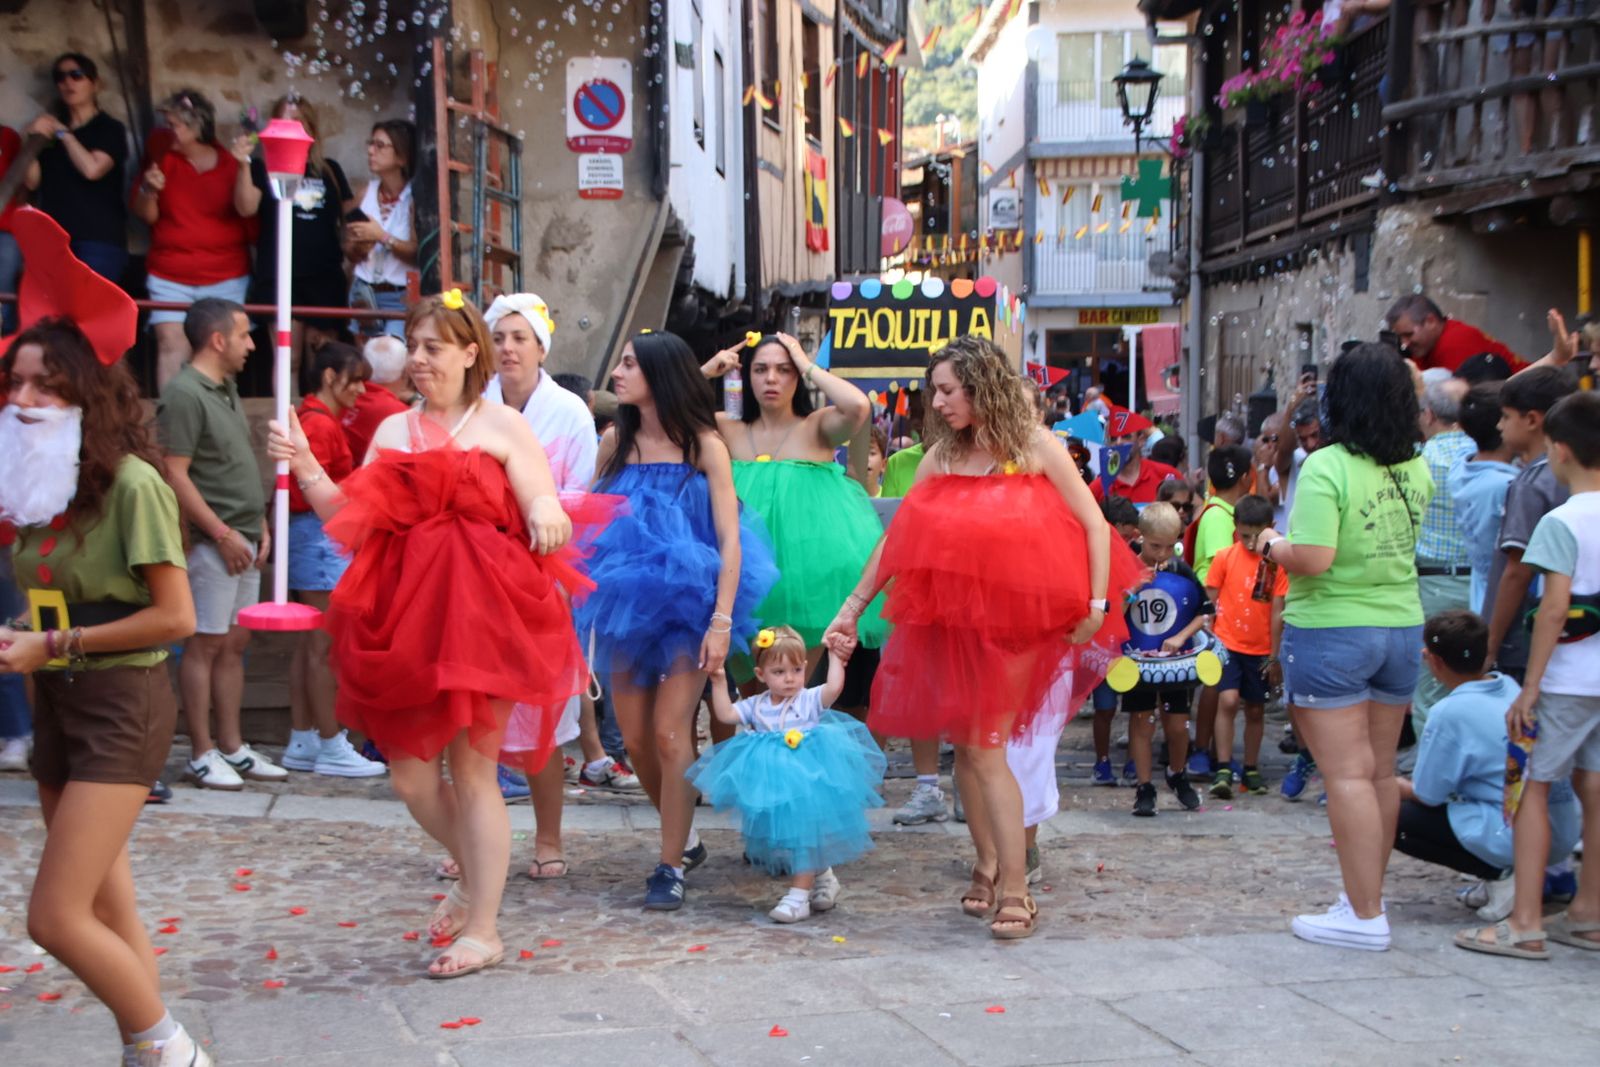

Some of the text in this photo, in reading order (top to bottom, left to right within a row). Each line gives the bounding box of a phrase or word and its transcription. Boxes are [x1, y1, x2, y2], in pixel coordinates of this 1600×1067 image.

[1079, 309, 1109, 324] BAR
[829, 307, 993, 348] TAQUILLA
[1115, 412, 1130, 432] 7
[1359, 499, 1376, 518] LA
[1137, 598, 1168, 624] 19
